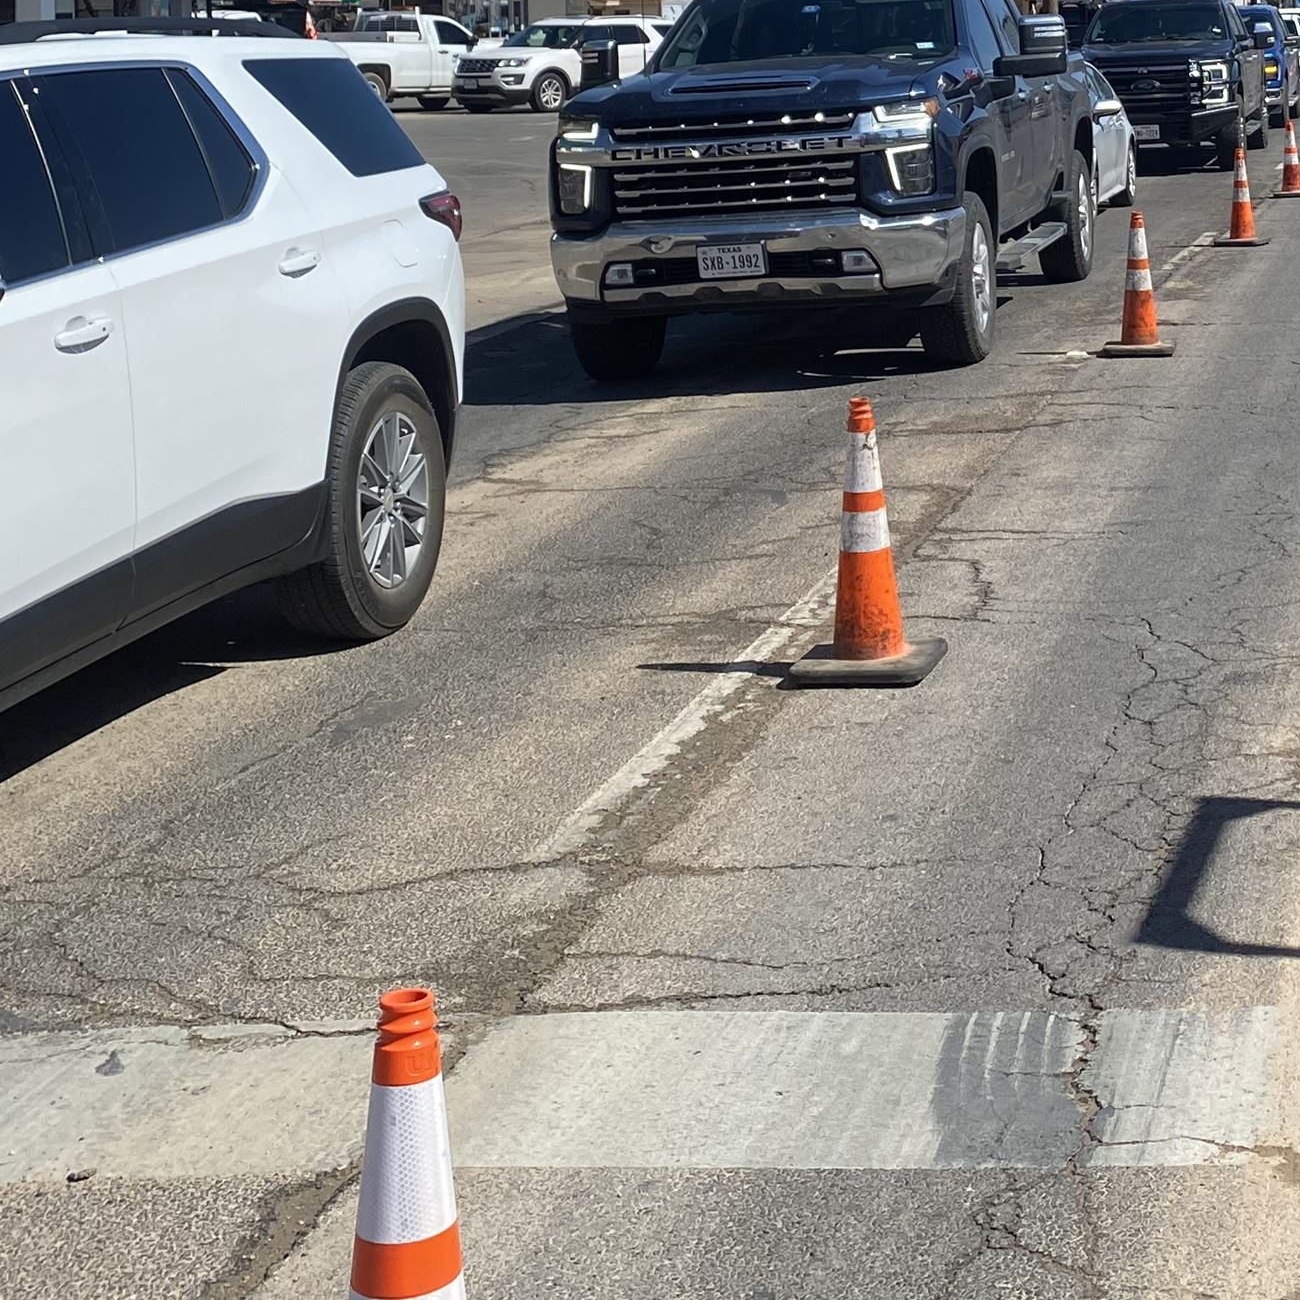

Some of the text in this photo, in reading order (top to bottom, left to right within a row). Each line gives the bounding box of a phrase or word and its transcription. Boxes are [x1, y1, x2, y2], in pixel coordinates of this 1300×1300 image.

[610, 135, 853, 162] CHEVROLET
[717, 246, 742, 254] TEXAS
[702, 253, 760, 271] SXB-1992
